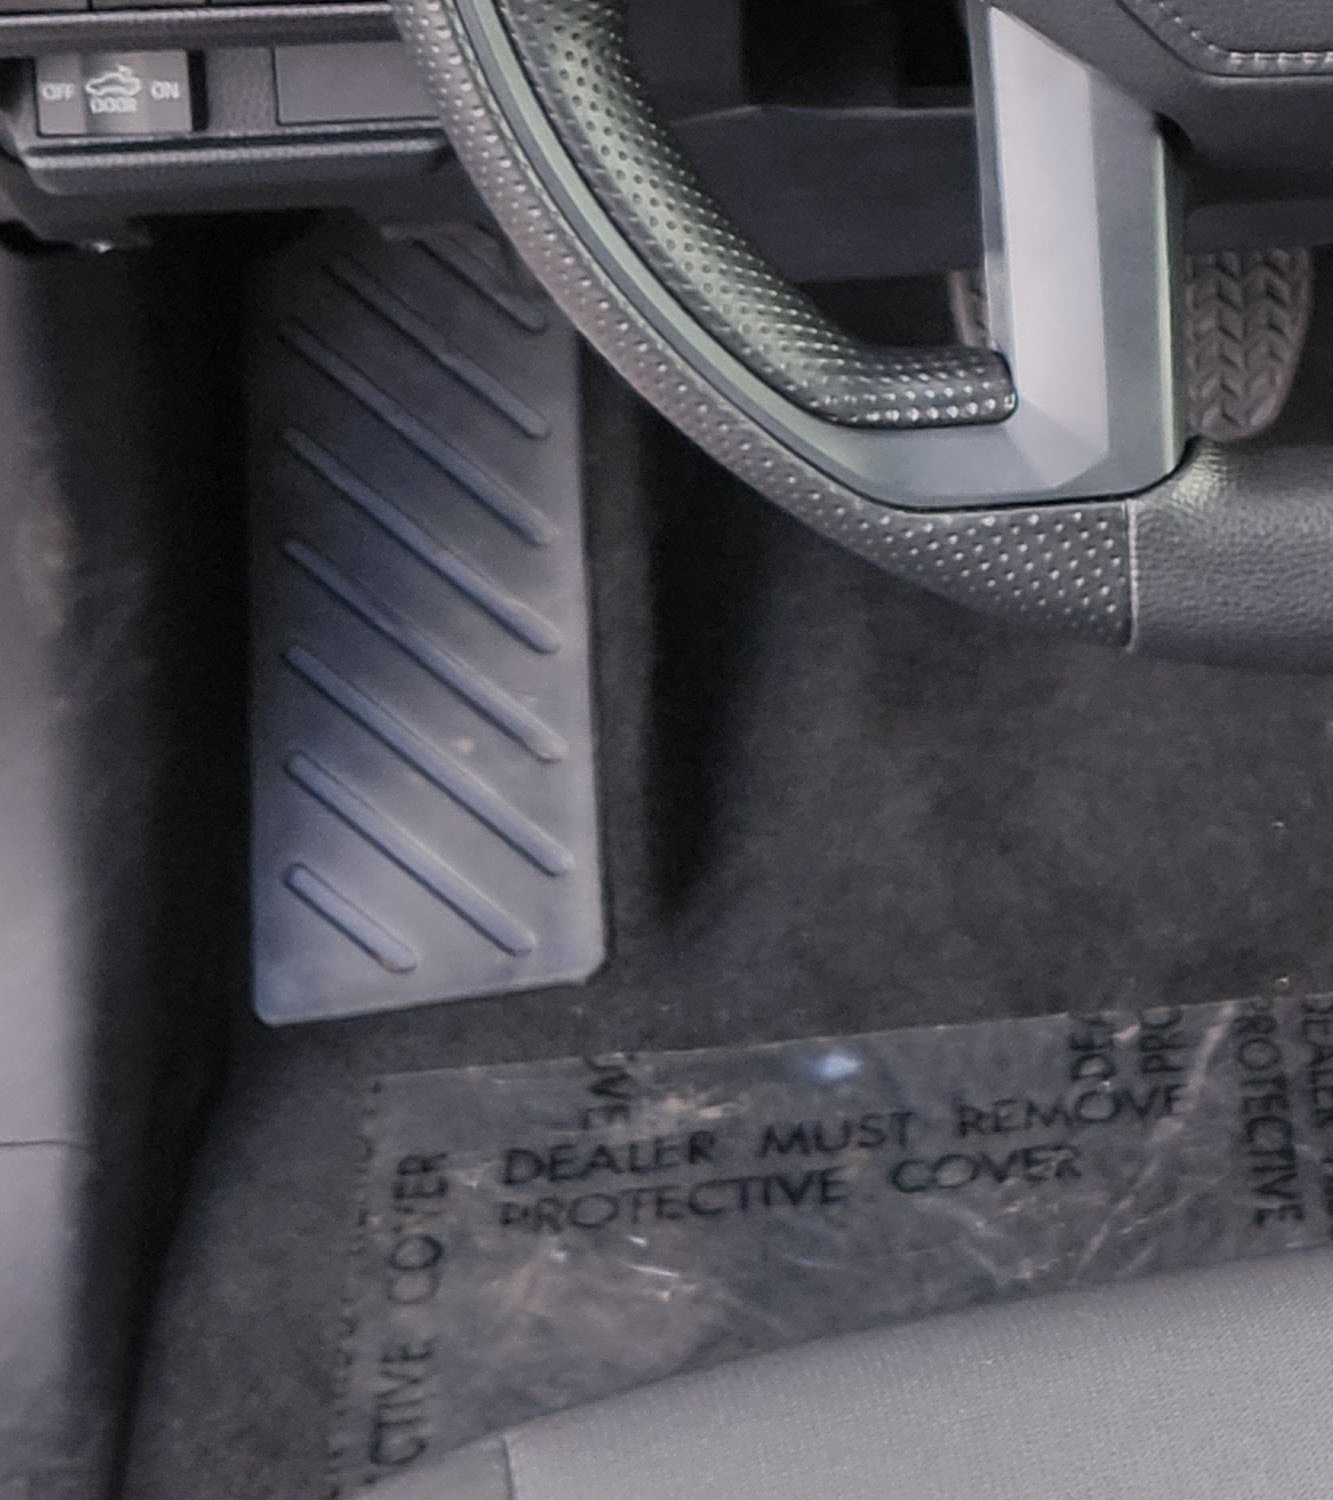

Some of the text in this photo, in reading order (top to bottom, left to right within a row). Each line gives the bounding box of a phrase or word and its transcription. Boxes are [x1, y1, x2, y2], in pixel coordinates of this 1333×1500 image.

[501, 1083, 1185, 1189] DEALER MUST REMOVE
[498, 1144, 1083, 1235] PROTECTIVE COVER
